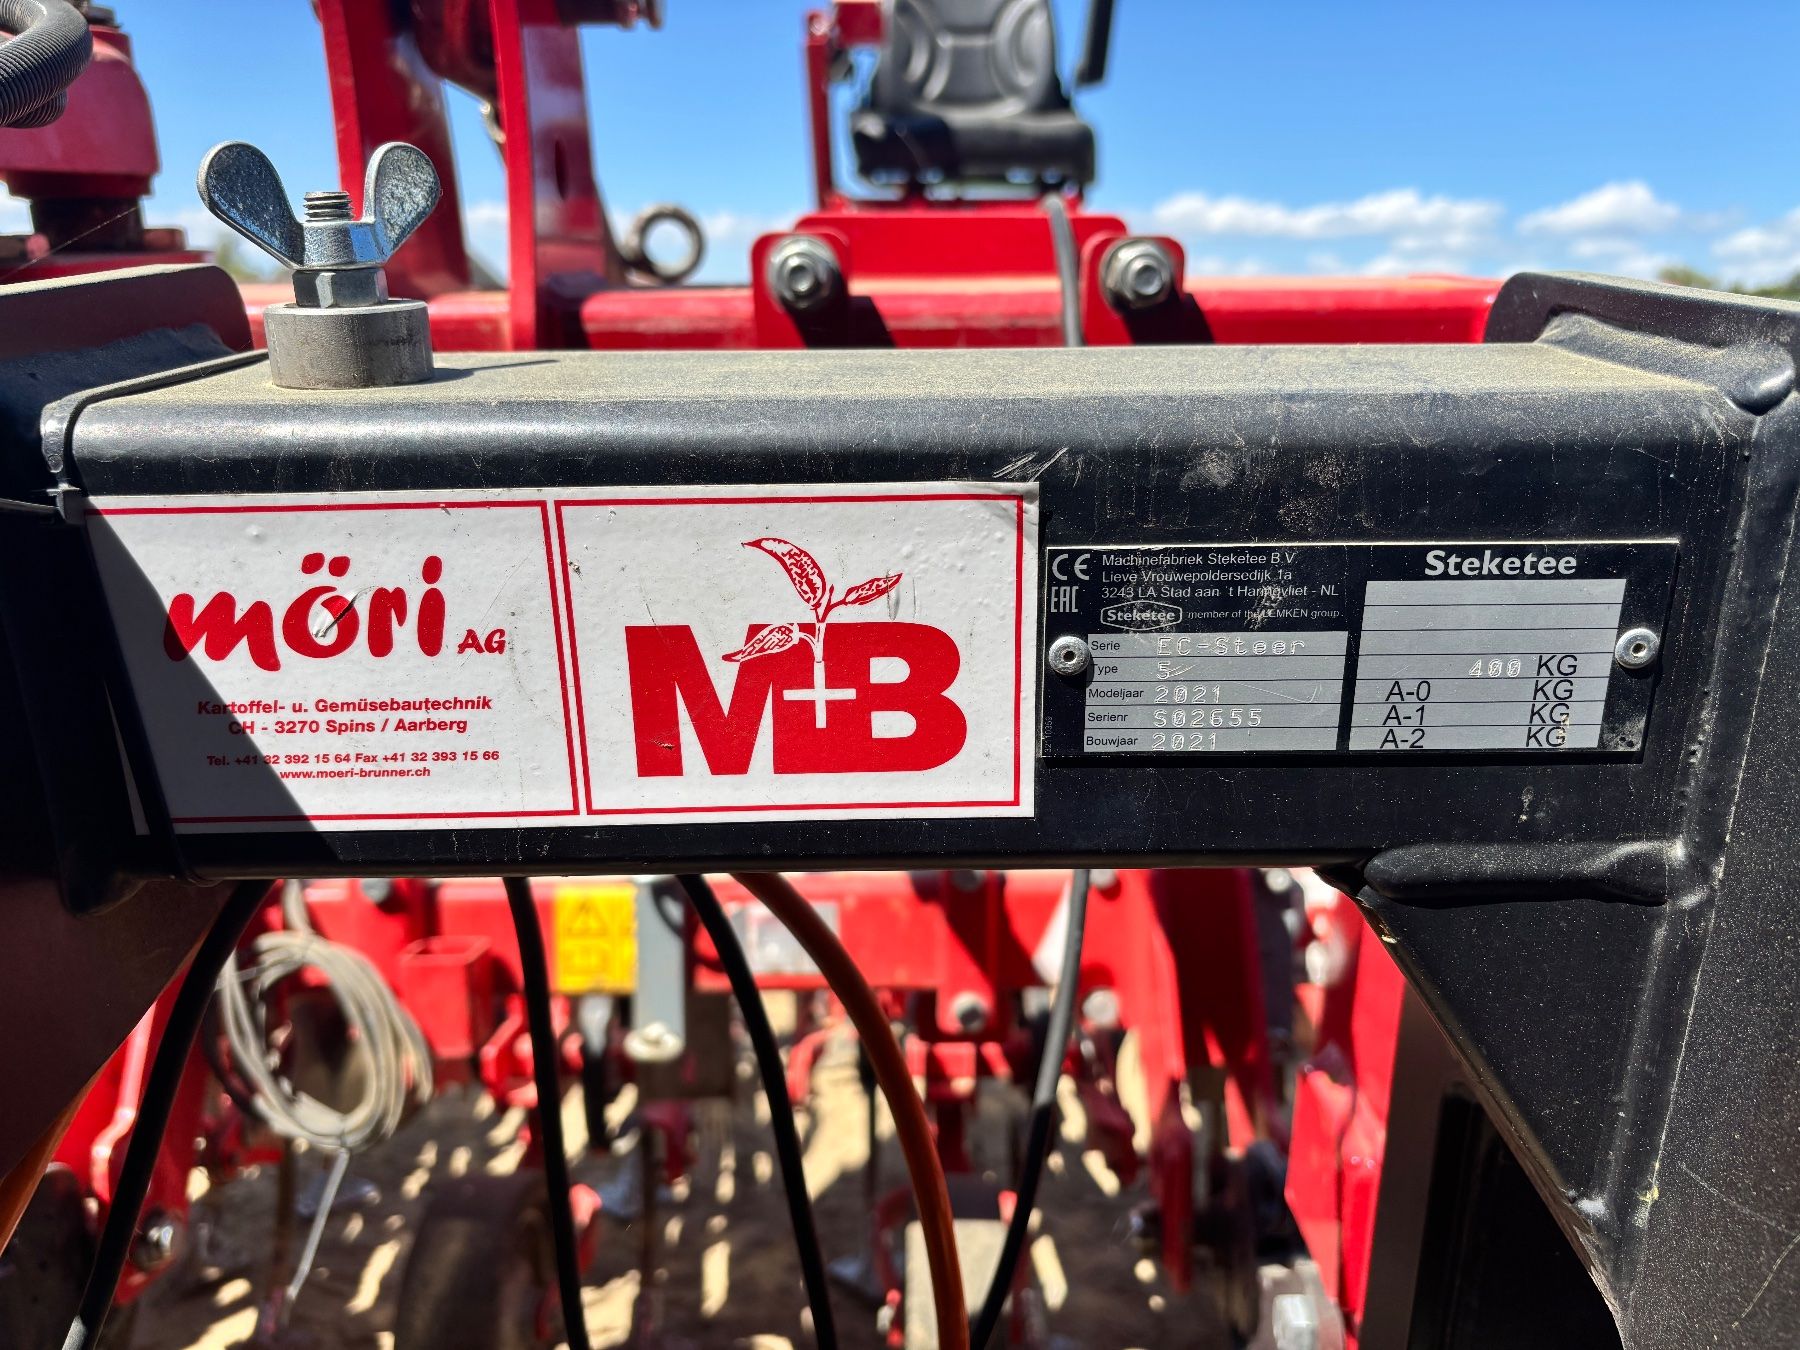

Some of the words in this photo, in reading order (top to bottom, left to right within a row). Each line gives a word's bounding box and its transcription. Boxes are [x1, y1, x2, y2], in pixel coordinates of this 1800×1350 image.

[1102, 553, 1203, 566] Machinefabriek
[1207, 552, 1267, 565] Steketee
[1424, 549, 1577, 576] Steketee
[1102, 571, 1138, 583] Lieve
[1278, 568, 1292, 580] 1a
[1050, 586, 1079, 613] EAC
[1101, 587, 1134, 599] 3243
[1138, 586, 1157, 598] LA
[1160, 586, 1191, 598] Stad
[1194, 588, 1220, 597] aan
[1320, 584, 1340, 596] NL
[164, 552, 445, 672] möri
[457, 628, 506, 655] AG
[1107, 609, 1176, 621] Steketee
[1188, 609, 1229, 619] member
[1231, 609, 1242, 618] of
[1091, 640, 1121, 651] Serie
[1156, 637, 1305, 656] EC-Steer
[1091, 662, 1118, 677] Type
[1468, 658, 1521, 678] 400
[1536, 654, 1578, 677] KG
[1088, 688, 1144, 700] Modeljaar
[1154, 685, 1221, 704] 2021
[1385, 680, 1432, 702] A-0
[1532, 679, 1574, 701] KG
[197, 698, 286, 715] Kartoffel-
[291, 700, 309, 714] u.
[314, 695, 492, 714] Gemüsebautechnik
[1382, 704, 1426, 726] A-1
[1528, 702, 1570, 725] KG
[228, 720, 255, 735] CH
[274, 719, 320, 734] 3270
[325, 718, 376, 736] Spins
[380, 718, 389, 733] /
[394, 717, 468, 735] Aarberg
[1087, 711, 1128, 723] Serienr
[1152, 708, 1263, 728] S02655
[1086, 735, 1138, 748] Bouwjaar
[1152, 733, 1217, 751] 2021
[1379, 727, 1426, 749] A-2
[1525, 726, 1567, 748] KG
[206, 754, 230, 766] Tel.
[234, 754, 258, 765] +41
[263, 754, 280, 765] 32
[284, 753, 310, 764] 392
[314, 753, 330, 764] 15
[334, 753, 351, 764] 64
[355, 752, 378, 763] Fax
[382, 752, 406, 763] +41
[410, 751, 428, 762] 32
[431, 750, 458, 762] 393
[462, 750, 478, 761] 15
[482, 750, 500, 761] 66
[279, 766, 431, 779] www.moeri-brunner.ch
